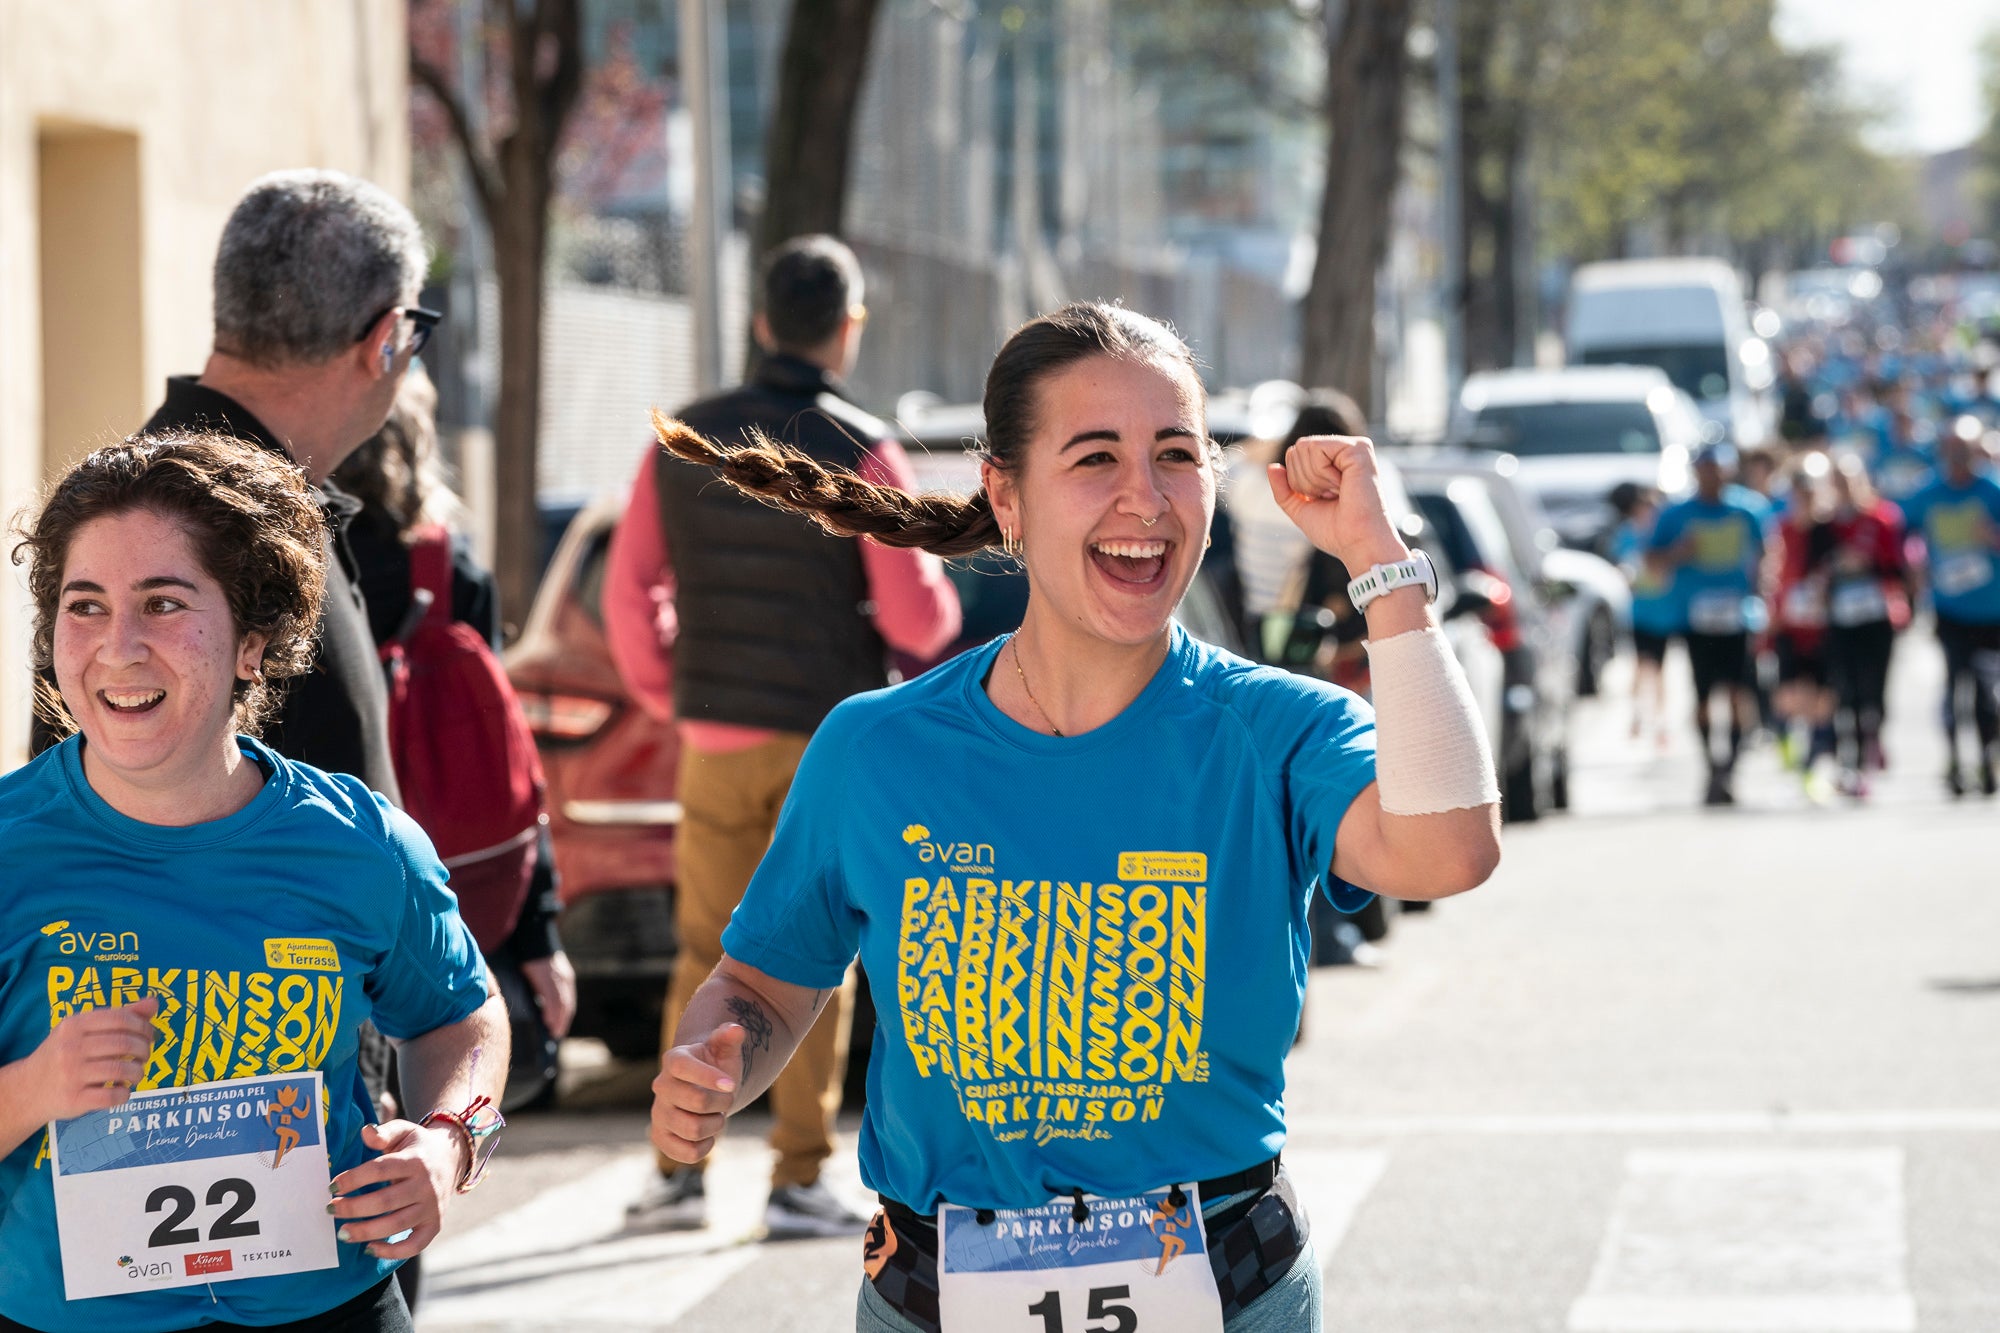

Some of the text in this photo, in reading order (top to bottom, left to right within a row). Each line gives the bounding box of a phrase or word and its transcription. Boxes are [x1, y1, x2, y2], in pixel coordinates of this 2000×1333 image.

[919, 842, 995, 864] avan
[950, 864, 995, 875] neurologia
[1143, 865, 1200, 877] Terrassa
[901, 876, 1207, 920] PARKINSON
[59, 931, 139, 955] avan
[94, 952, 139, 963] neurologia
[287, 953, 336, 967] Terrassa
[897, 940, 1205, 986] PARKINSON
[48, 966, 344, 1014] PARKINSON
[897, 973, 1205, 1020] PARKINSON
[900, 1008, 1203, 1052] PARKINSON
[170, 1097, 175, 1106] I
[178, 1088, 245, 1106] PASSEJADA
[247, 1086, 266, 1097] PEL
[965, 1080, 1165, 1099] CURSA I PASSEJADA PEL
[108, 1099, 270, 1135] PARKINSON
[958, 1093, 1165, 1124] ARKINSON
[146, 1121, 240, 1150] Leonor González
[145, 1178, 260, 1248] 22
[996, 1208, 1154, 1240] PARKINSON
[128, 1261, 172, 1279] avan
[242, 1249, 292, 1262] TEXTURA
[1028, 1284, 1138, 1333] 15
